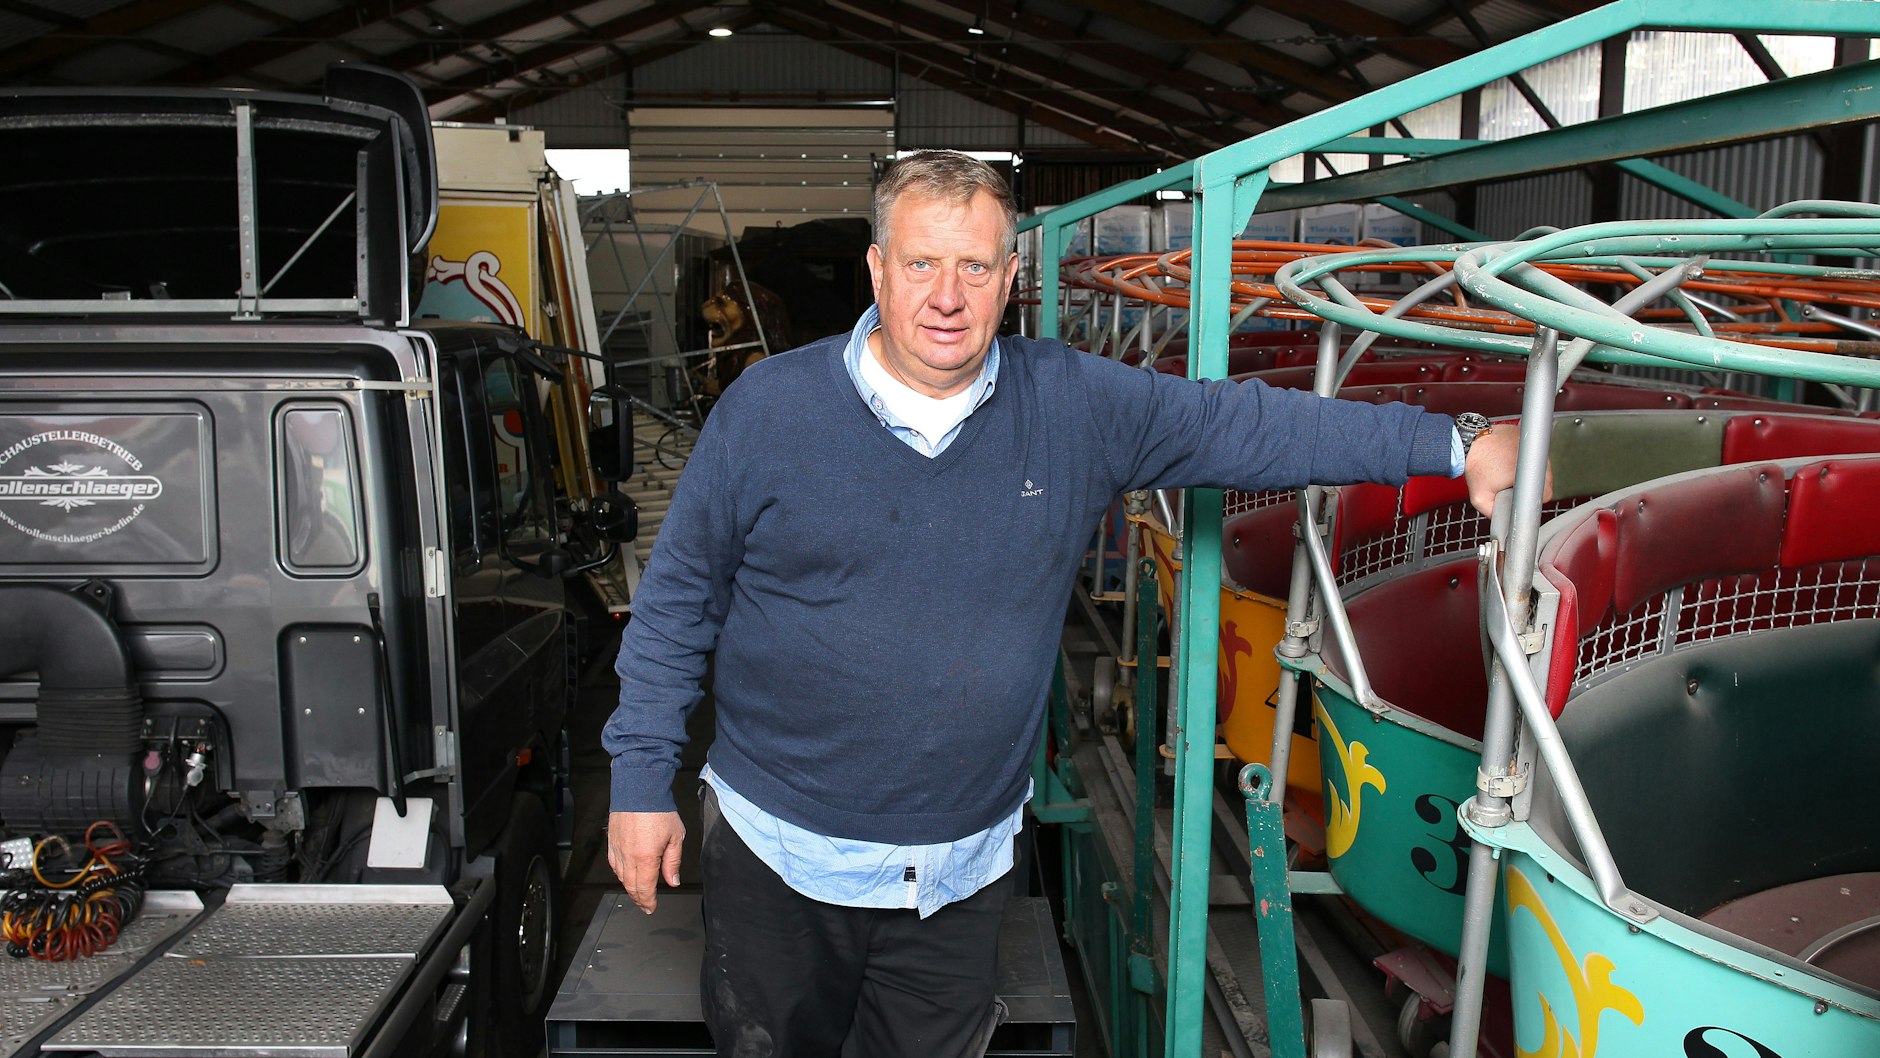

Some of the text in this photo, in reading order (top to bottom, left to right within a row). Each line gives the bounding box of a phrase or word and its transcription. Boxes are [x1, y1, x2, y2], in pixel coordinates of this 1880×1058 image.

[0, 430, 143, 471] CHAUSTELLERBETRIEB
[0, 503, 145, 543] ww.wollenschlaeger-berlin.de
[1411, 794, 1471, 896] 3
